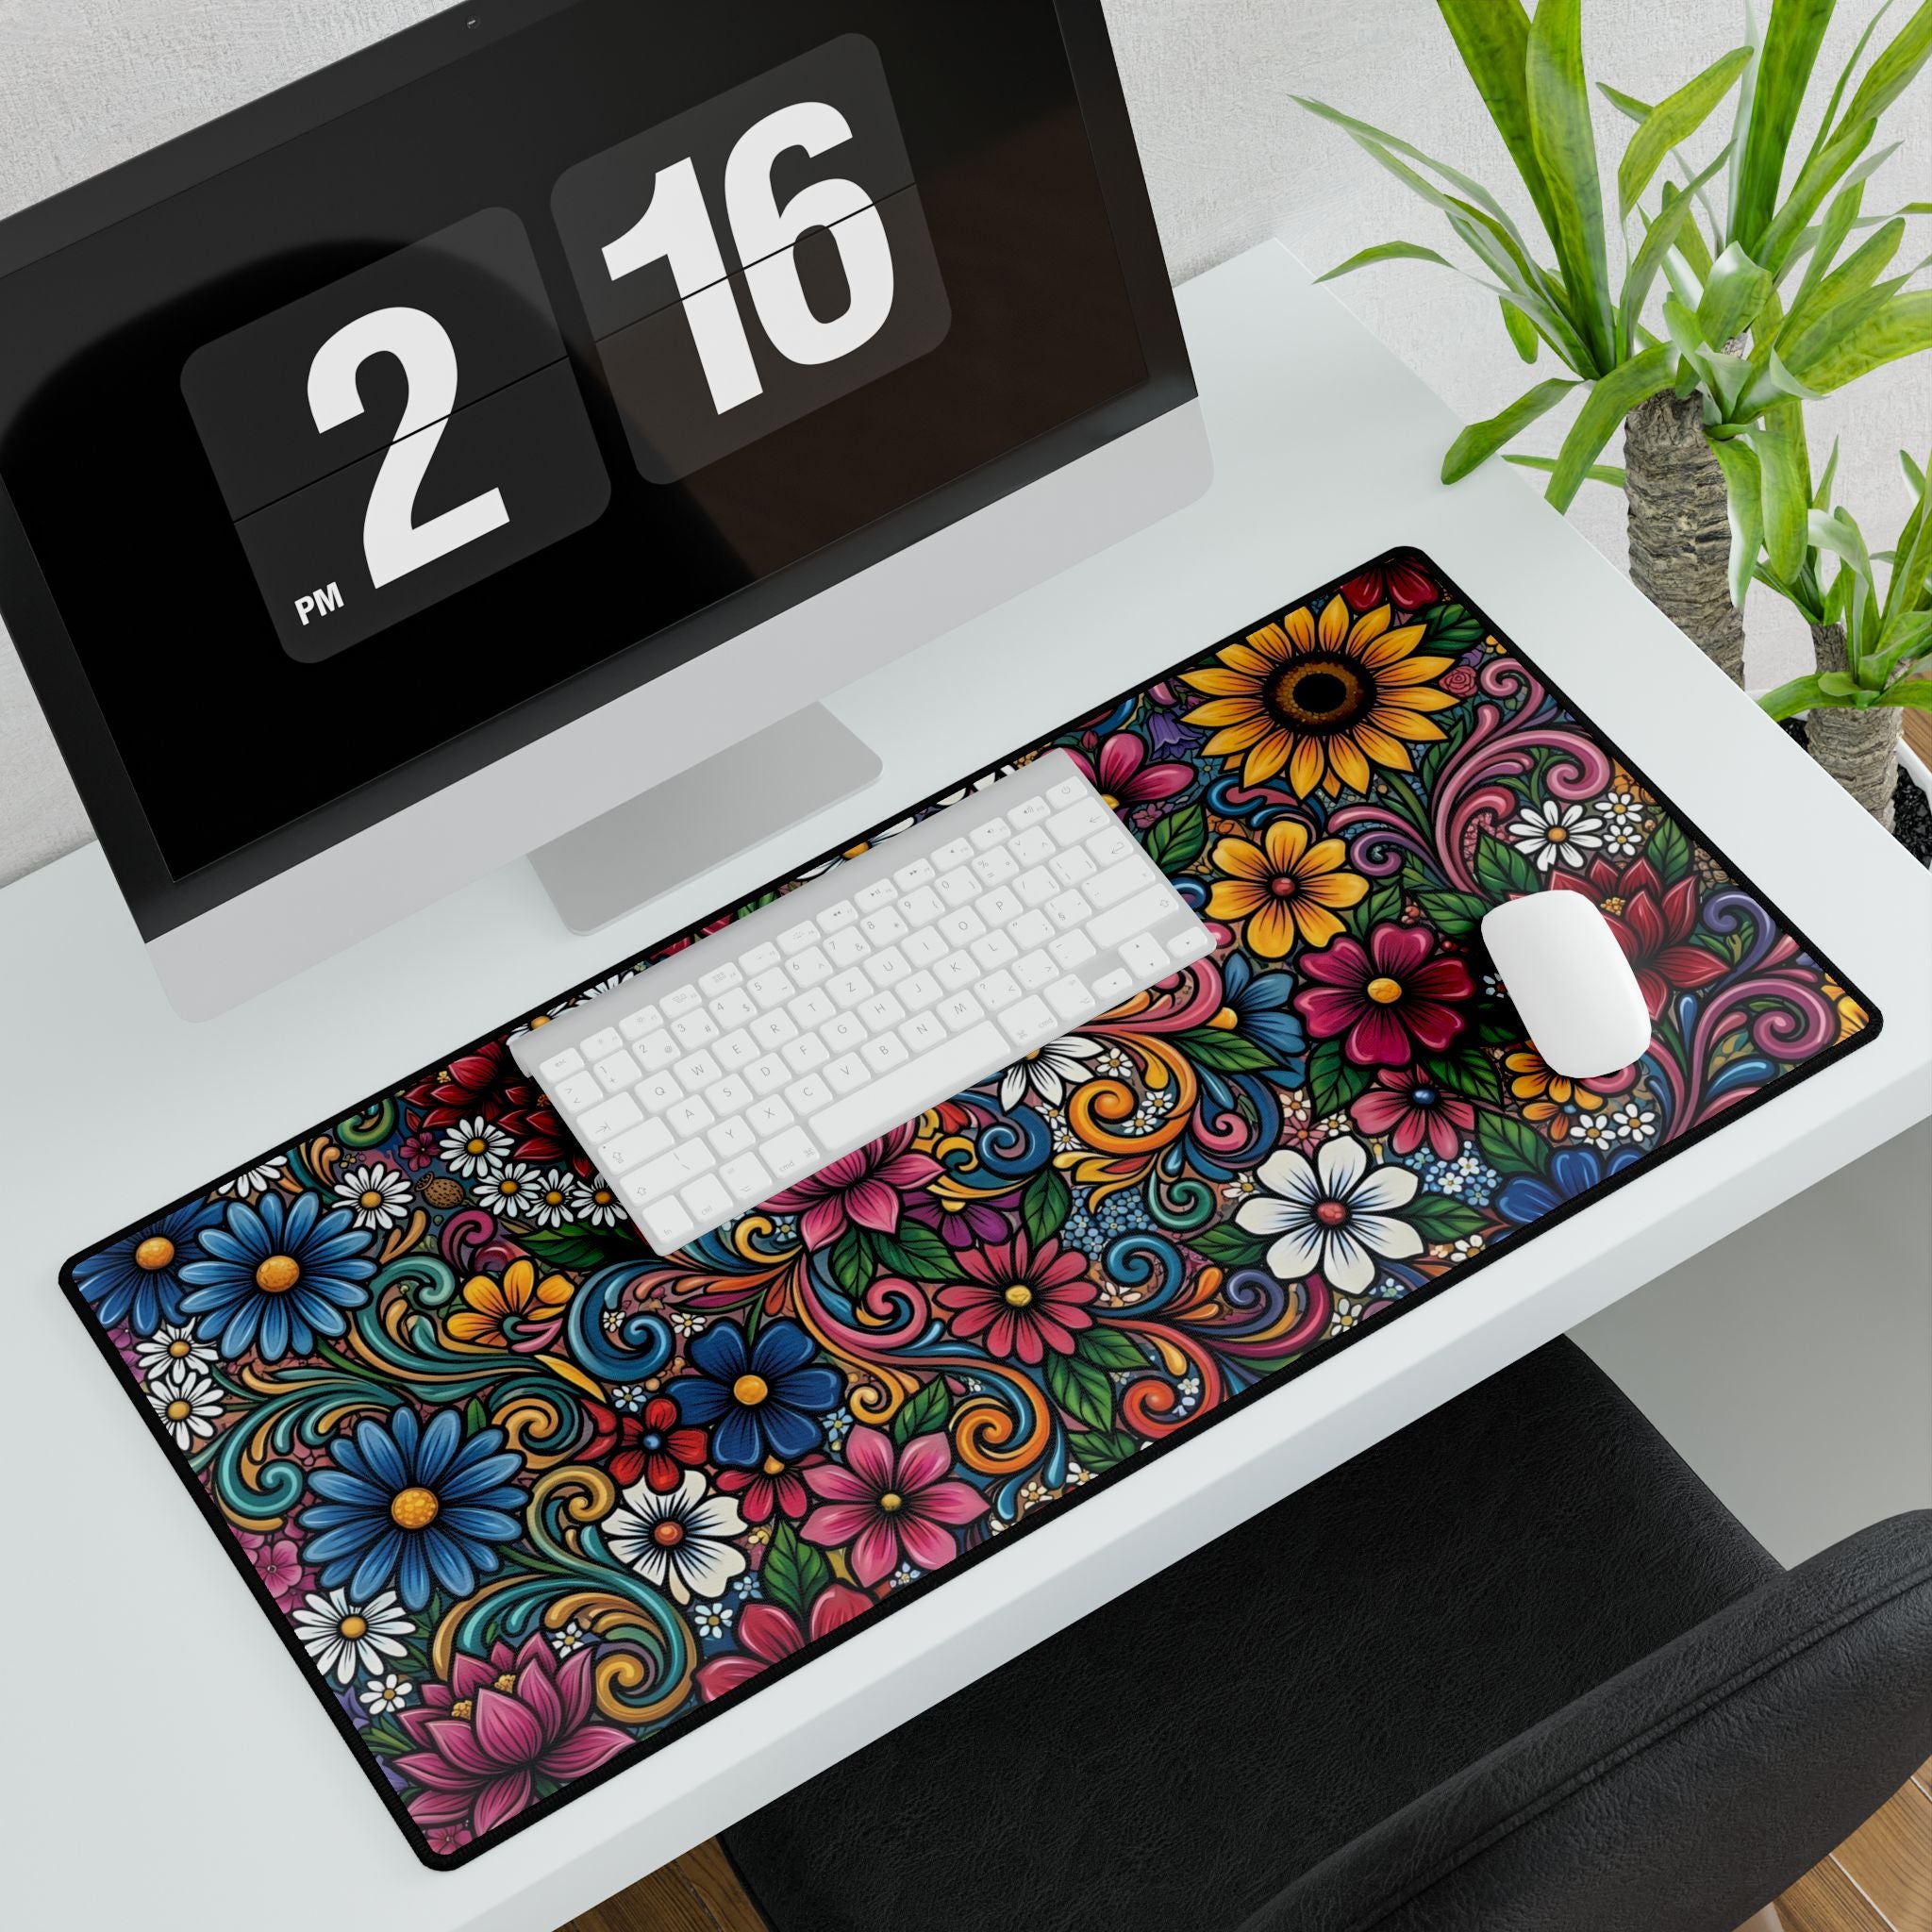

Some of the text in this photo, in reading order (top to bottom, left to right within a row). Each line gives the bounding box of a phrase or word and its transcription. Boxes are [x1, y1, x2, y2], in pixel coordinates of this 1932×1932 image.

[308, 102, 893, 589] 2 16
[294, 582, 343, 625] PM
[639, 1044, 648, 1055] 2
[676, 1023, 687, 1033] 3
[866, 921, 875, 930] 8
[903, 900, 912, 910] 9
[941, 879, 951, 890] 0
[654, 1086, 666, 1096] Q
[691, 1064, 705, 1076] W
[731, 1044, 741, 1055] E
[770, 1024, 780, 1034] R
[807, 1003, 817, 1012] T
[845, 981, 857, 993] Z
[882, 960, 893, 972] U
[958, 921, 969, 931] O
[685, 1108, 695, 1120] A
[723, 1087, 732, 1098] S
[759, 1066, 771, 1077] D
[837, 1024, 848, 1035] G
[874, 1003, 886, 1014] H
[950, 961, 961, 973] K
[554, 1058, 567, 1068] esc
[724, 1003, 967, 1140] Y X C V B N M
[778, 1159, 795, 1173] cmd
[1038, 1016, 1055, 1028] cmd
